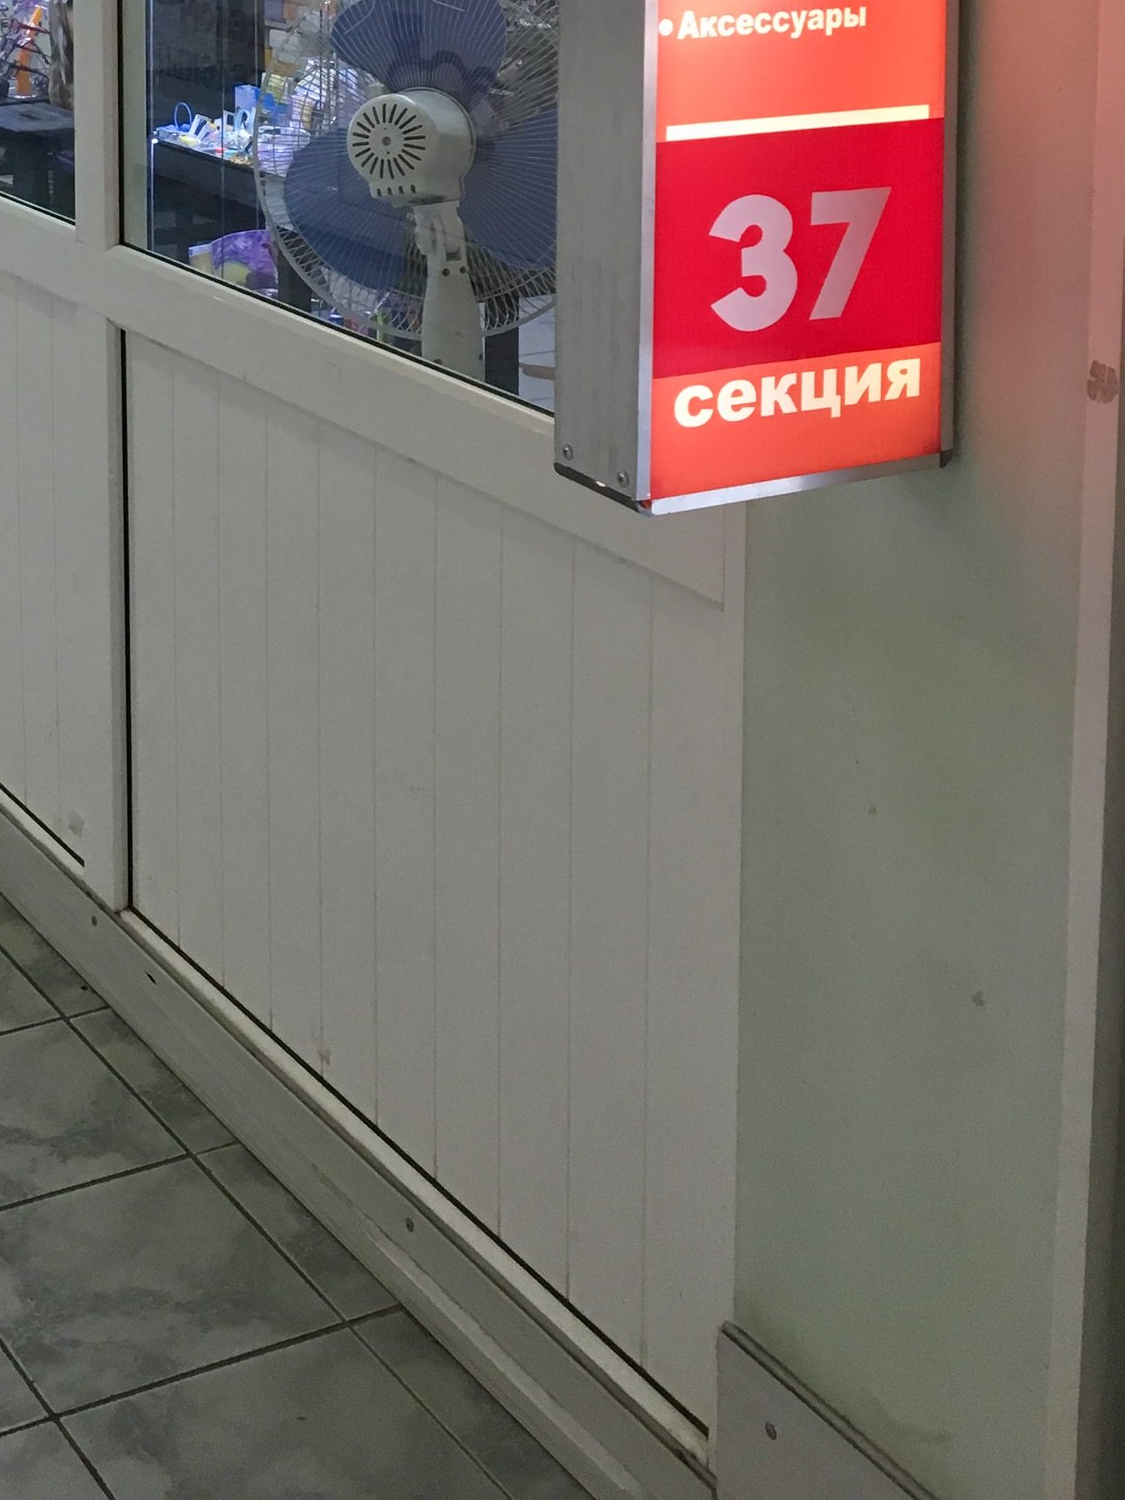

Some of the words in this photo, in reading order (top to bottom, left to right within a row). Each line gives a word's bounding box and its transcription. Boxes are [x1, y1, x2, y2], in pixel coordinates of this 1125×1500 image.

[677, 6, 867, 39] Аксессуары
[708, 186, 892, 332] 37
[674, 358, 920, 428] секция
